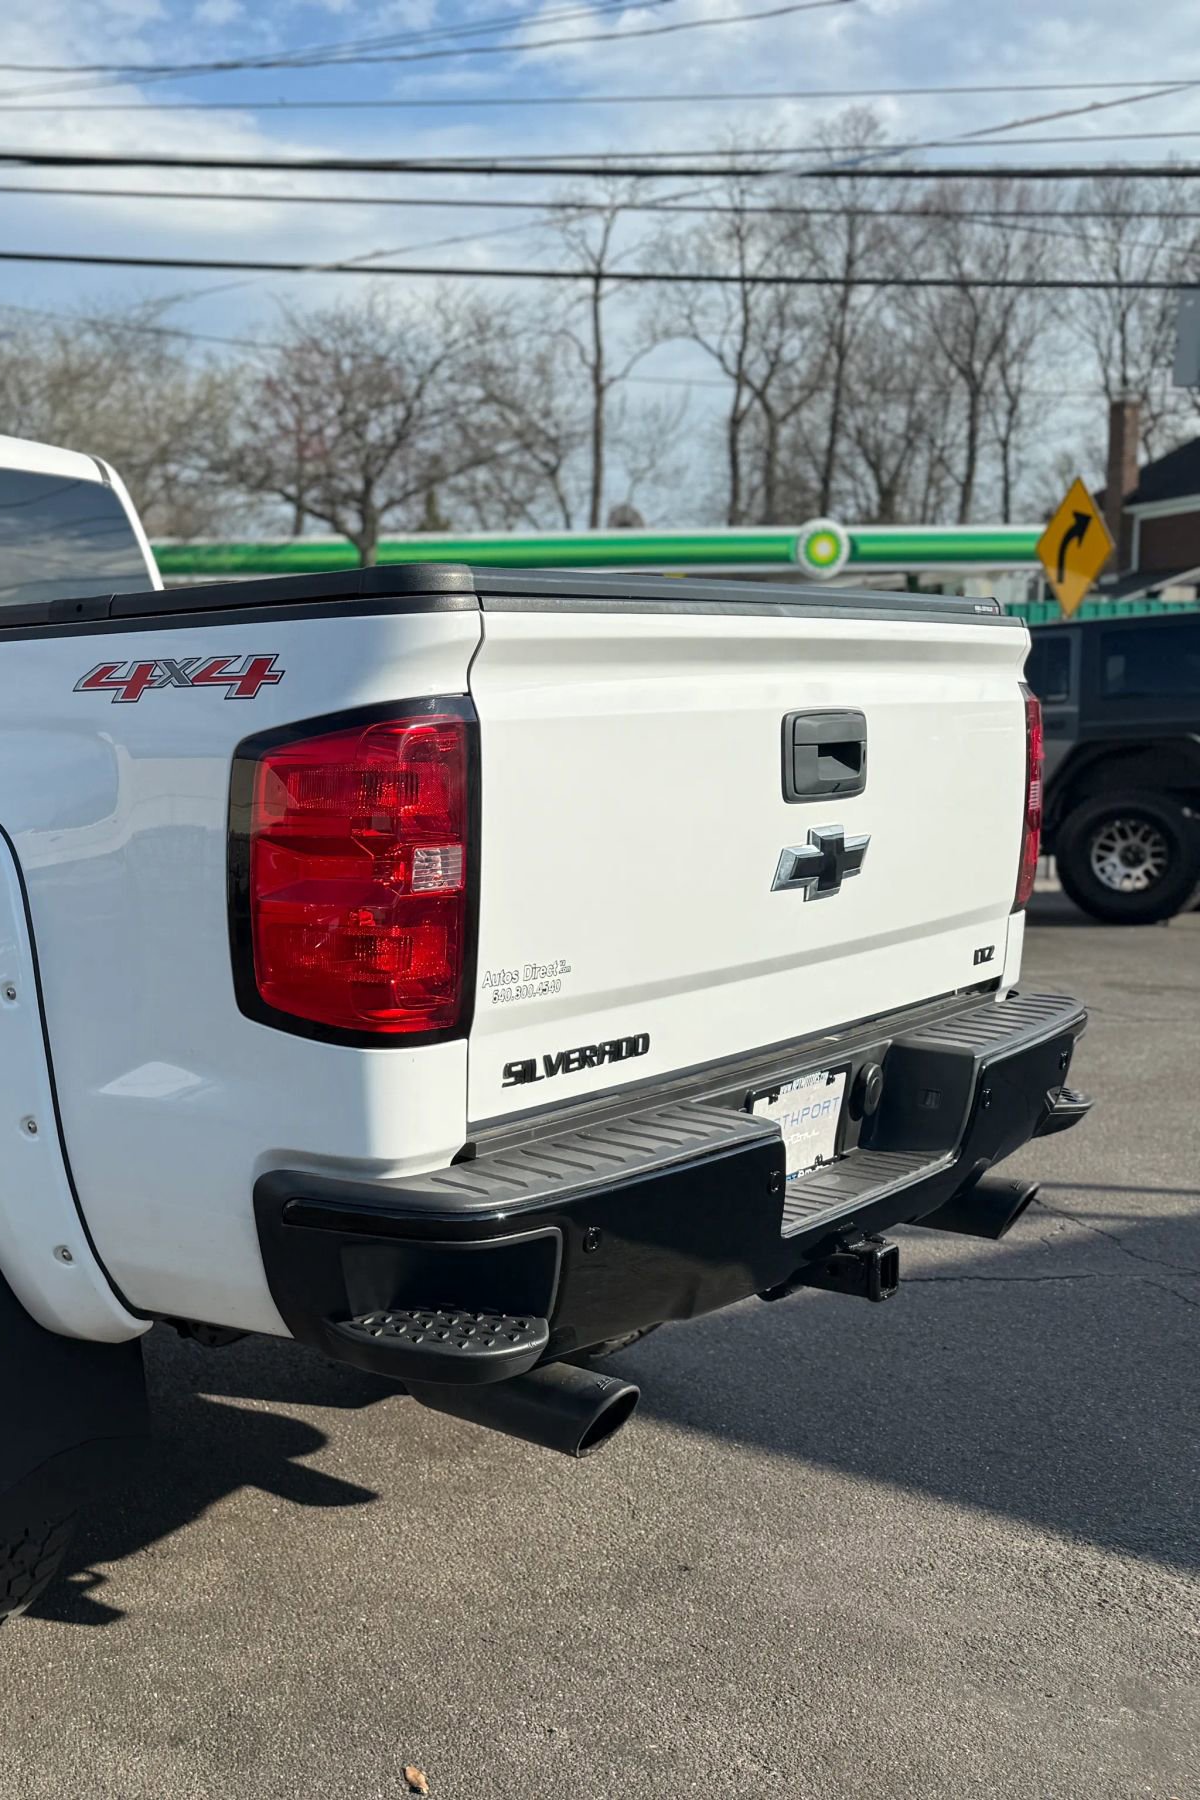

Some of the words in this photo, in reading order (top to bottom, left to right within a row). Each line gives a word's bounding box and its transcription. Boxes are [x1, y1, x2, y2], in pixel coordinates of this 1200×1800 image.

[482, 969, 519, 988] Autos
[523, 960, 558, 981] Direct
[492, 979, 561, 1004] 540.300.4540
[502, 1032, 650, 1088] SILVERADO
[777, 1097, 840, 1129] THPORT
